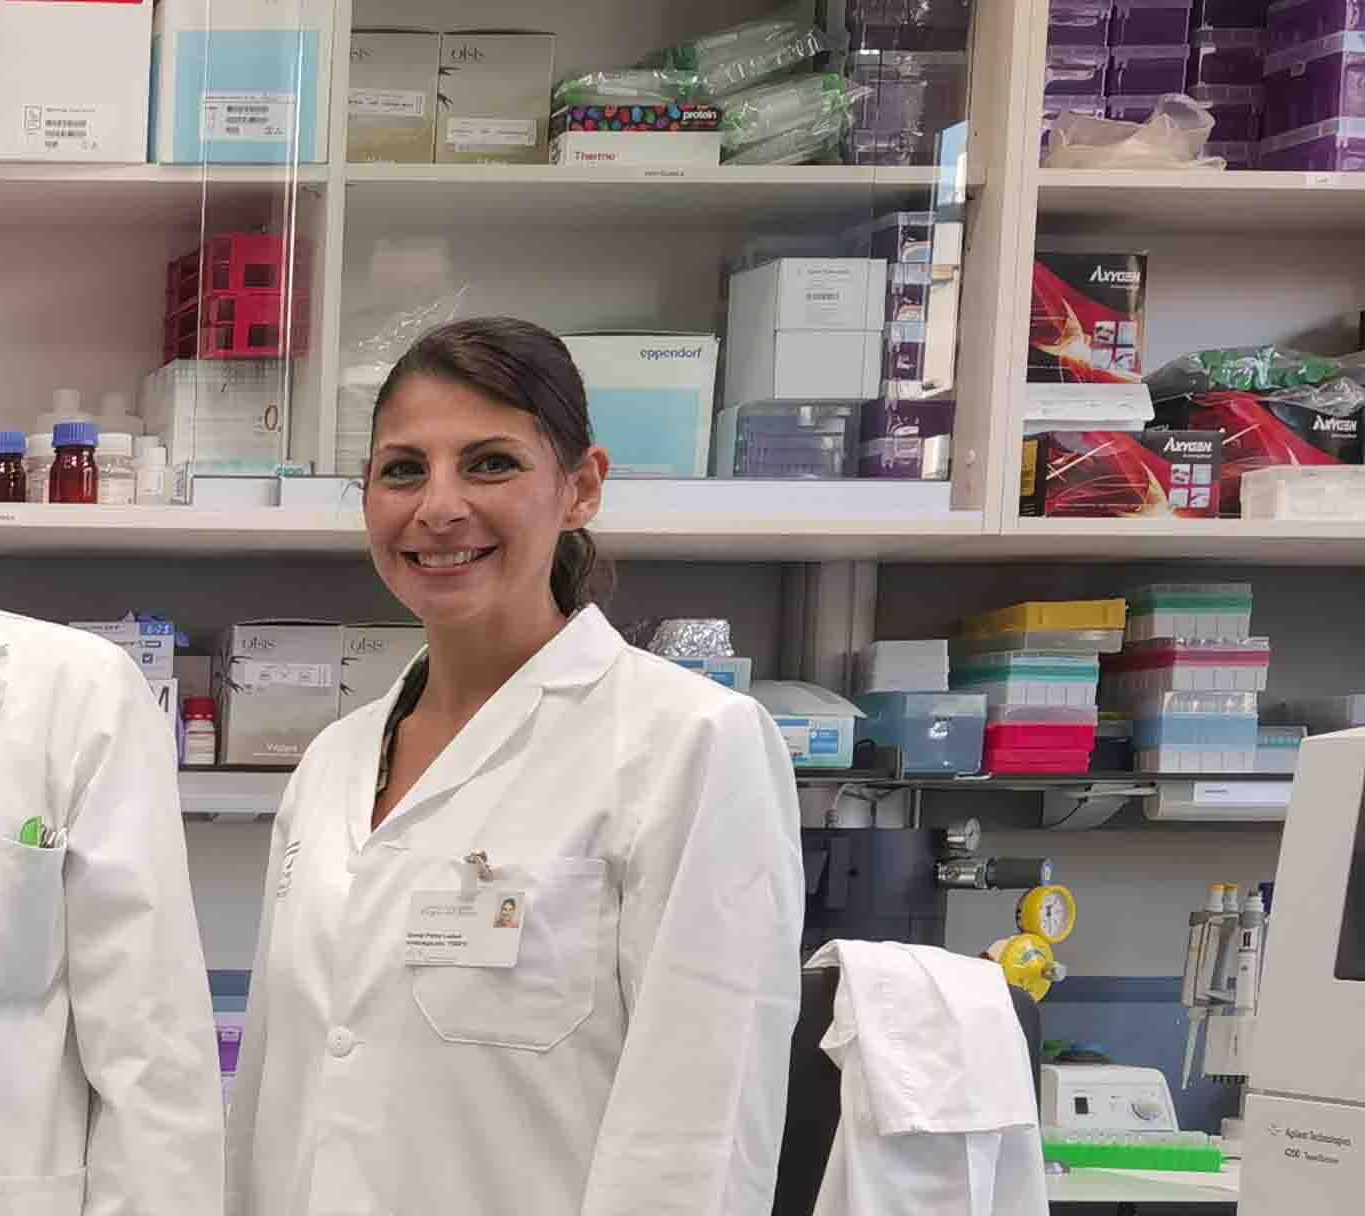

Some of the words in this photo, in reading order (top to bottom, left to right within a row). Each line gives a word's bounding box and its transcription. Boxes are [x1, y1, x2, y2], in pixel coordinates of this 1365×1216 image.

[682, 110, 718, 121] protein
[573, 151, 616, 161] Thermo
[640, 347, 702, 360] eppendorf
